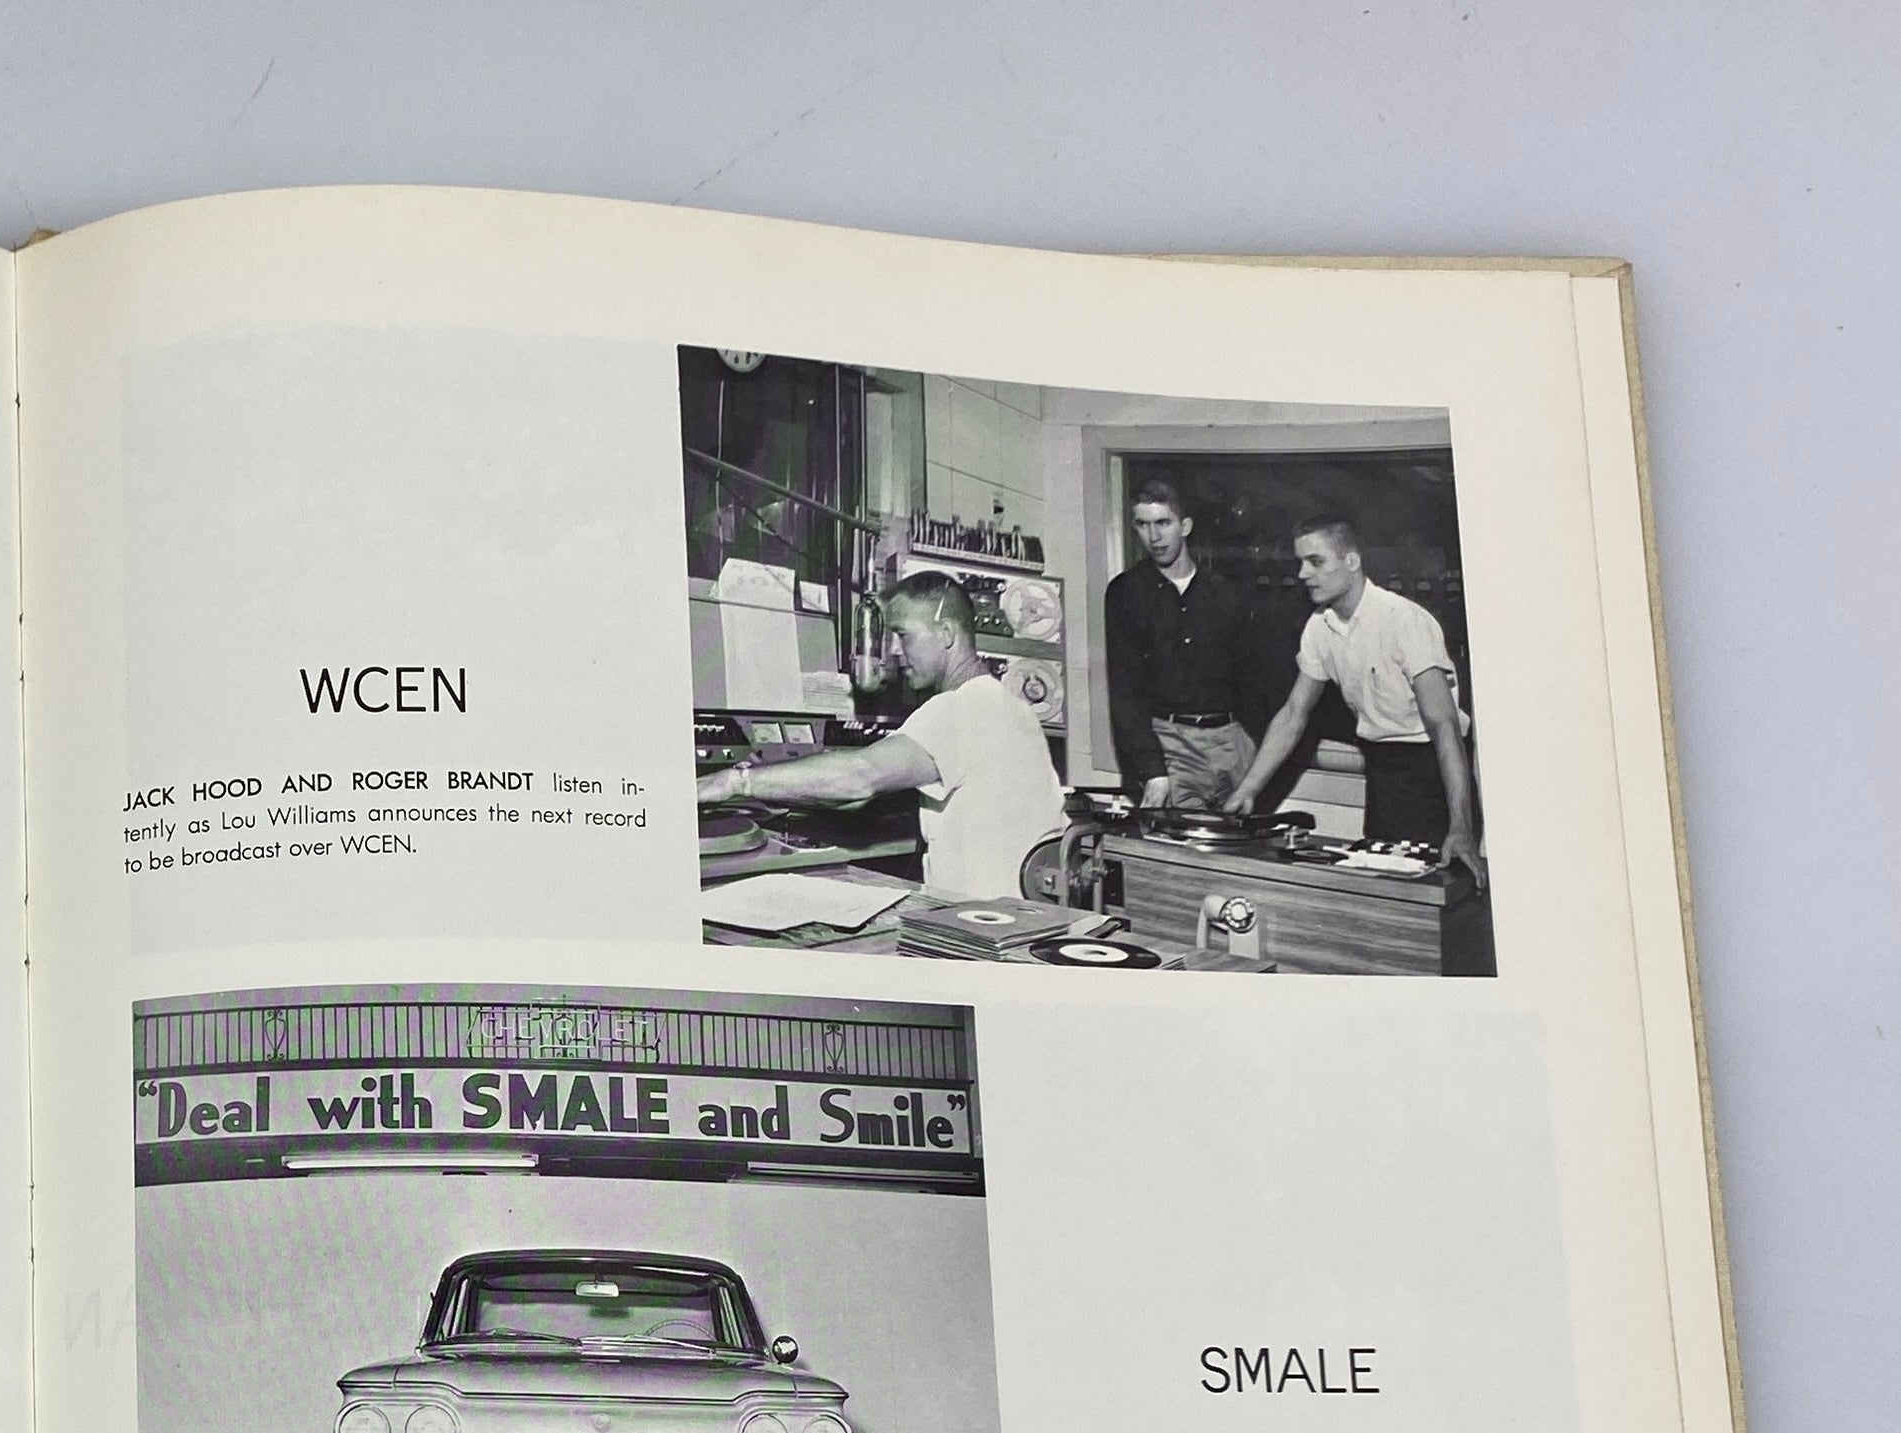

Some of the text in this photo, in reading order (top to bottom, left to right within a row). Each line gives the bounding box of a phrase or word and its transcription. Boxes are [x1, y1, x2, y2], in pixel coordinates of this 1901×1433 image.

[299, 666, 466, 714] WCEN
[122, 770, 645, 813] JACK HOOD AND ROGER BRANDT listen in-
[123, 802, 647, 844] tently as Lou Williams announces the next record
[124, 834, 417, 874] to be broadcast over WCEN.
[306, 1073, 433, 1132] with
[461, 1071, 670, 1134] SMALE
[697, 1085, 791, 1143] and
[1200, 1346, 1380, 1394] SMALE
